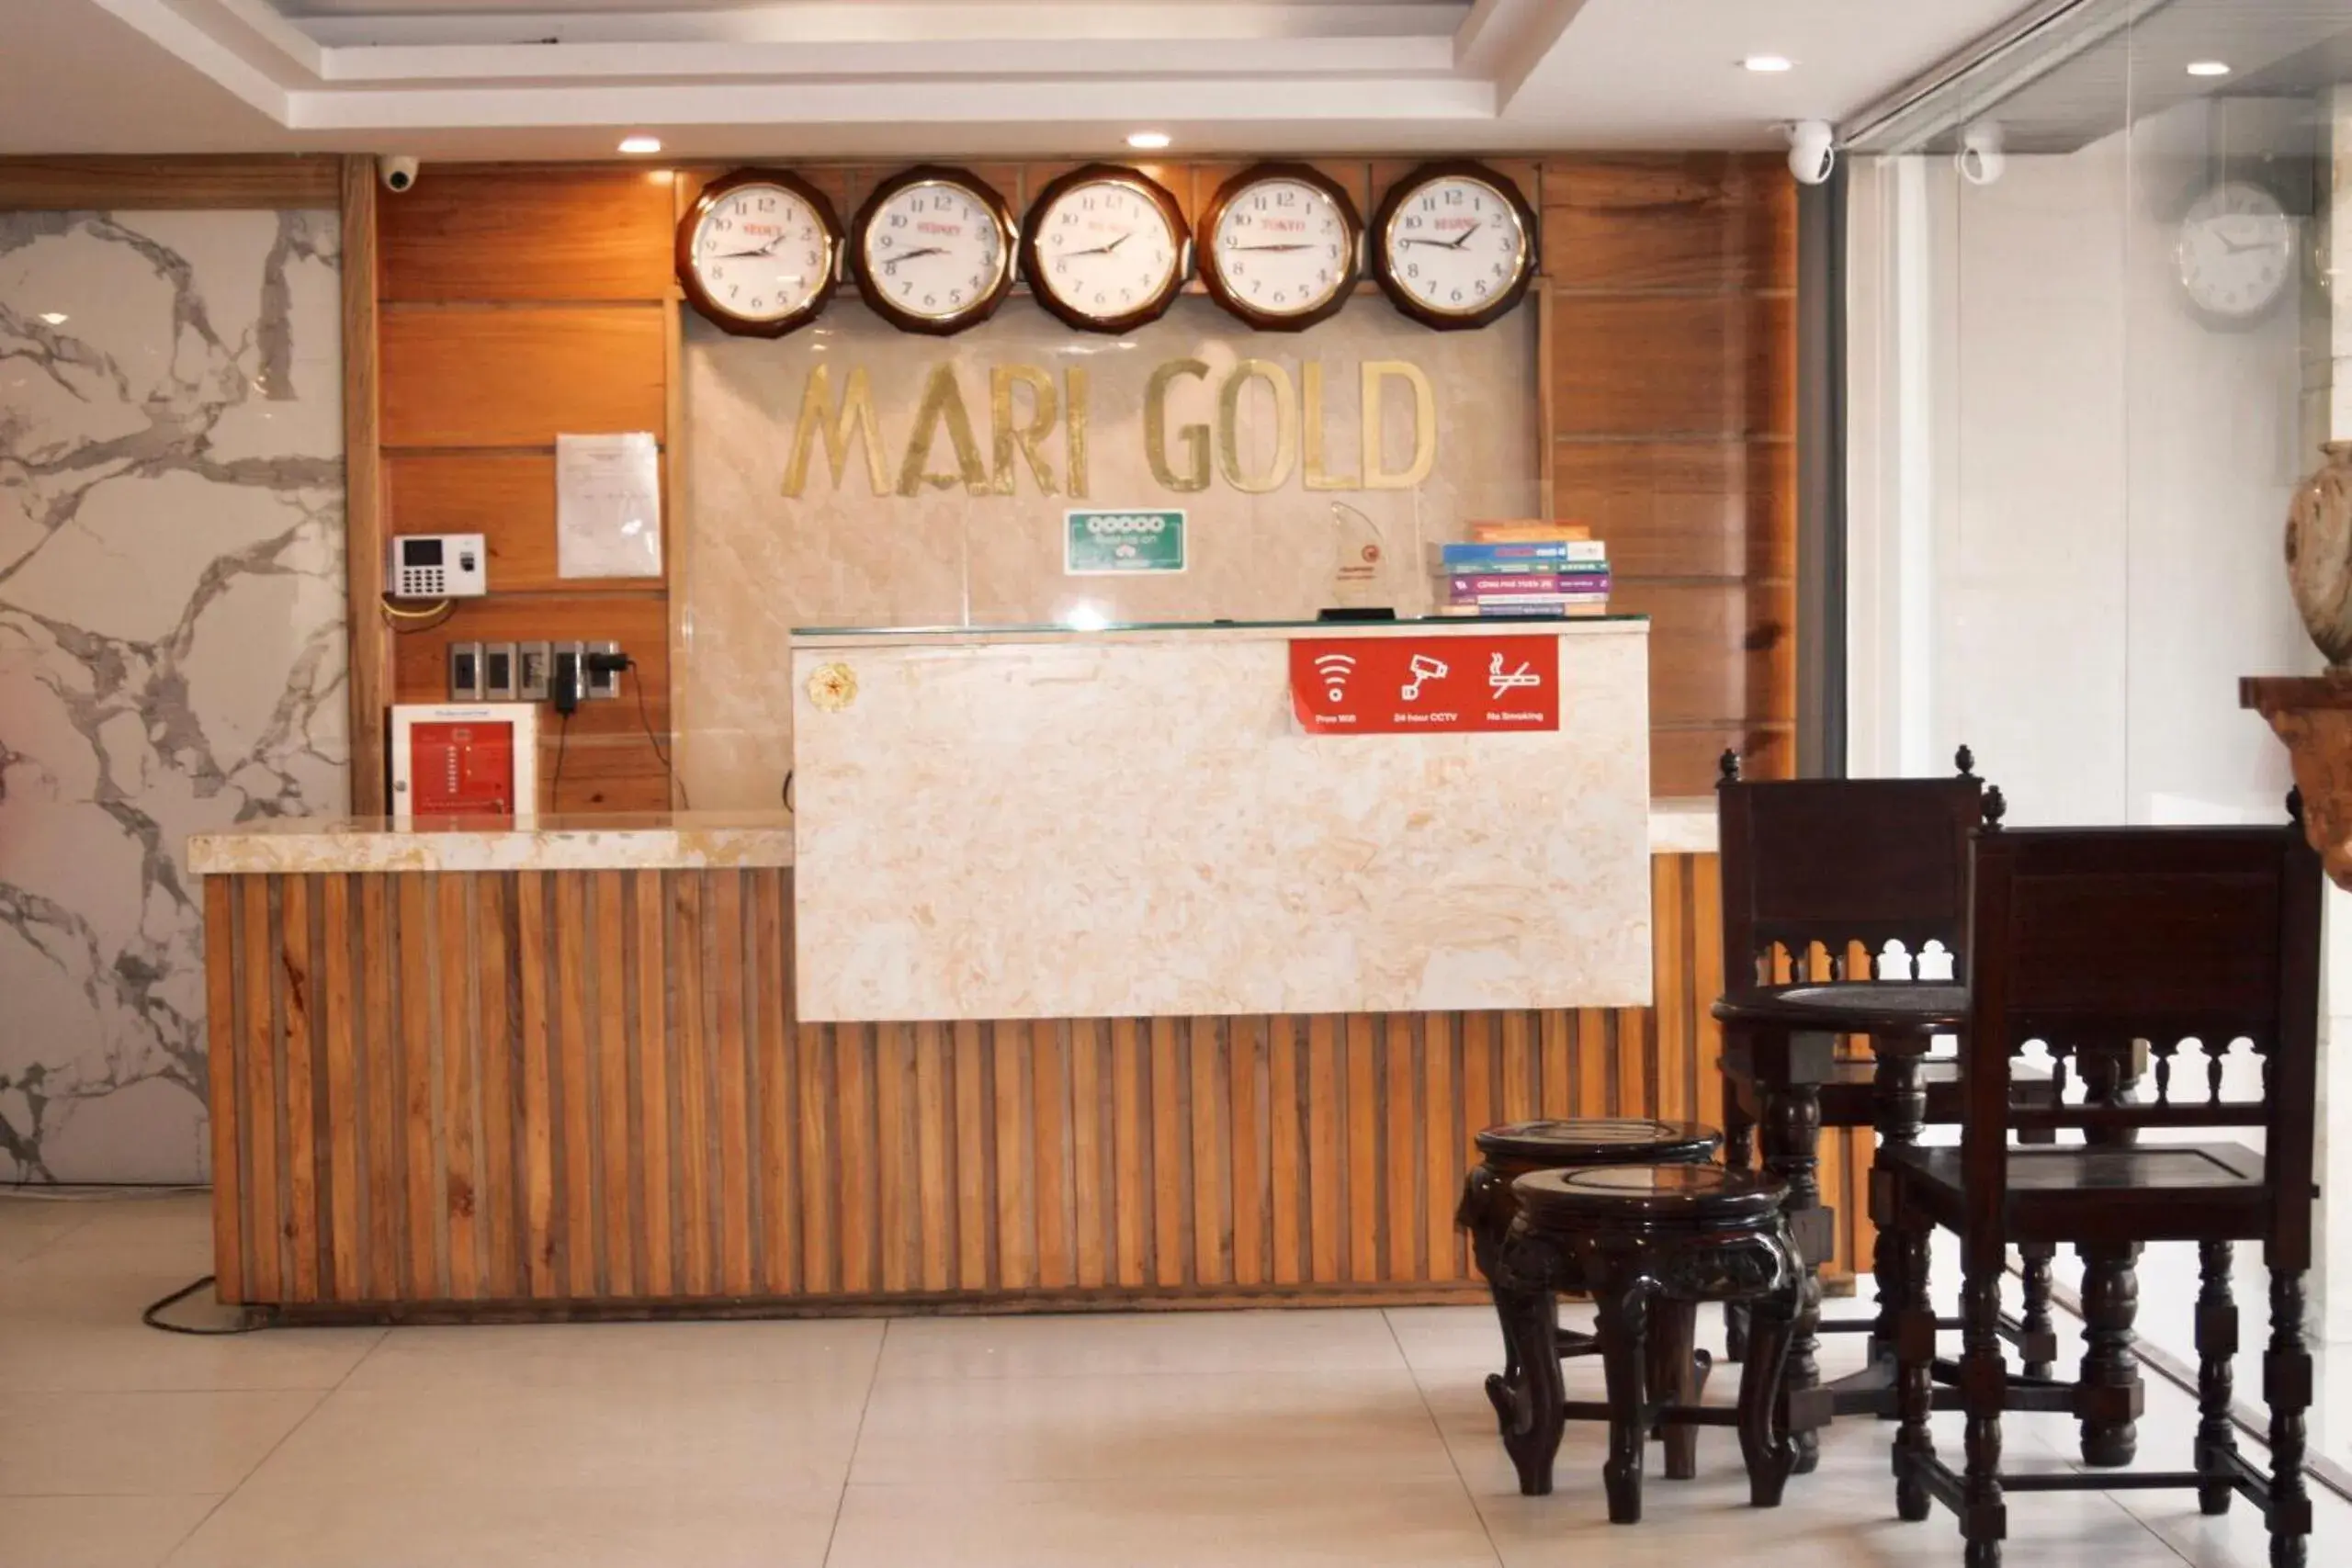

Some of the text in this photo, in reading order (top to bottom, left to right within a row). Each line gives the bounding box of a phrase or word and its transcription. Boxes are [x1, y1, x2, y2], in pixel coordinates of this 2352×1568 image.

[758, 197, 775, 212] 12
[933, 195, 952, 211] 12
[1254, 197, 1267, 210] 11
[1277, 192, 1295, 207] 12
[1422, 197, 1435, 211] 11
[1444, 189, 1462, 206] 12
[735, 201, 747, 215] 11
[911, 199, 923, 212] 11
[715, 218, 733, 231] 10
[890, 213, 908, 228] 10
[1235, 212, 1251, 226] 10
[1406, 215, 1422, 229] 10
[1490, 213, 1502, 229] 2
[801, 226, 812, 241] 2
[977, 226, 989, 241] 2
[1320, 220, 1332, 235] 2
[707, 240, 717, 252] 9
[880, 235, 892, 248] 9
[1226, 235, 1238, 249] 9
[1398, 238, 1410, 252] 9
[1498, 237, 1510, 252] 3
[806, 250, 817, 266] 3
[979, 250, 991, 265] 3
[1328, 243, 1338, 259] 3
[711, 265, 724, 279] 8
[884, 261, 897, 276] 8
[1233, 261, 1244, 276] 8
[1316, 268, 1327, 283] 4
[1407, 263, 1419, 278] 8
[1490, 263, 1502, 276] 4
[902, 281, 913, 296] 7
[968, 275, 979, 289] 4
[1251, 278, 1261, 293] 7
[1427, 280, 1437, 294] 7
[1475, 279, 1487, 294] 5
[729, 284, 739, 298] 7
[776, 290, 788, 304] 5
[950, 288, 962, 303] 5
[1273, 291, 1285, 303] 6
[1298, 284, 1310, 298] 5
[1451, 288, 1463, 302] 6
[752, 298, 763, 310] 6
[923, 294, 936, 307] 6
[781, 357, 1439, 499] MARI GOLD
[1430, 713, 1458, 722] CCTV
[1486, 712, 1544, 722] No Smoking
